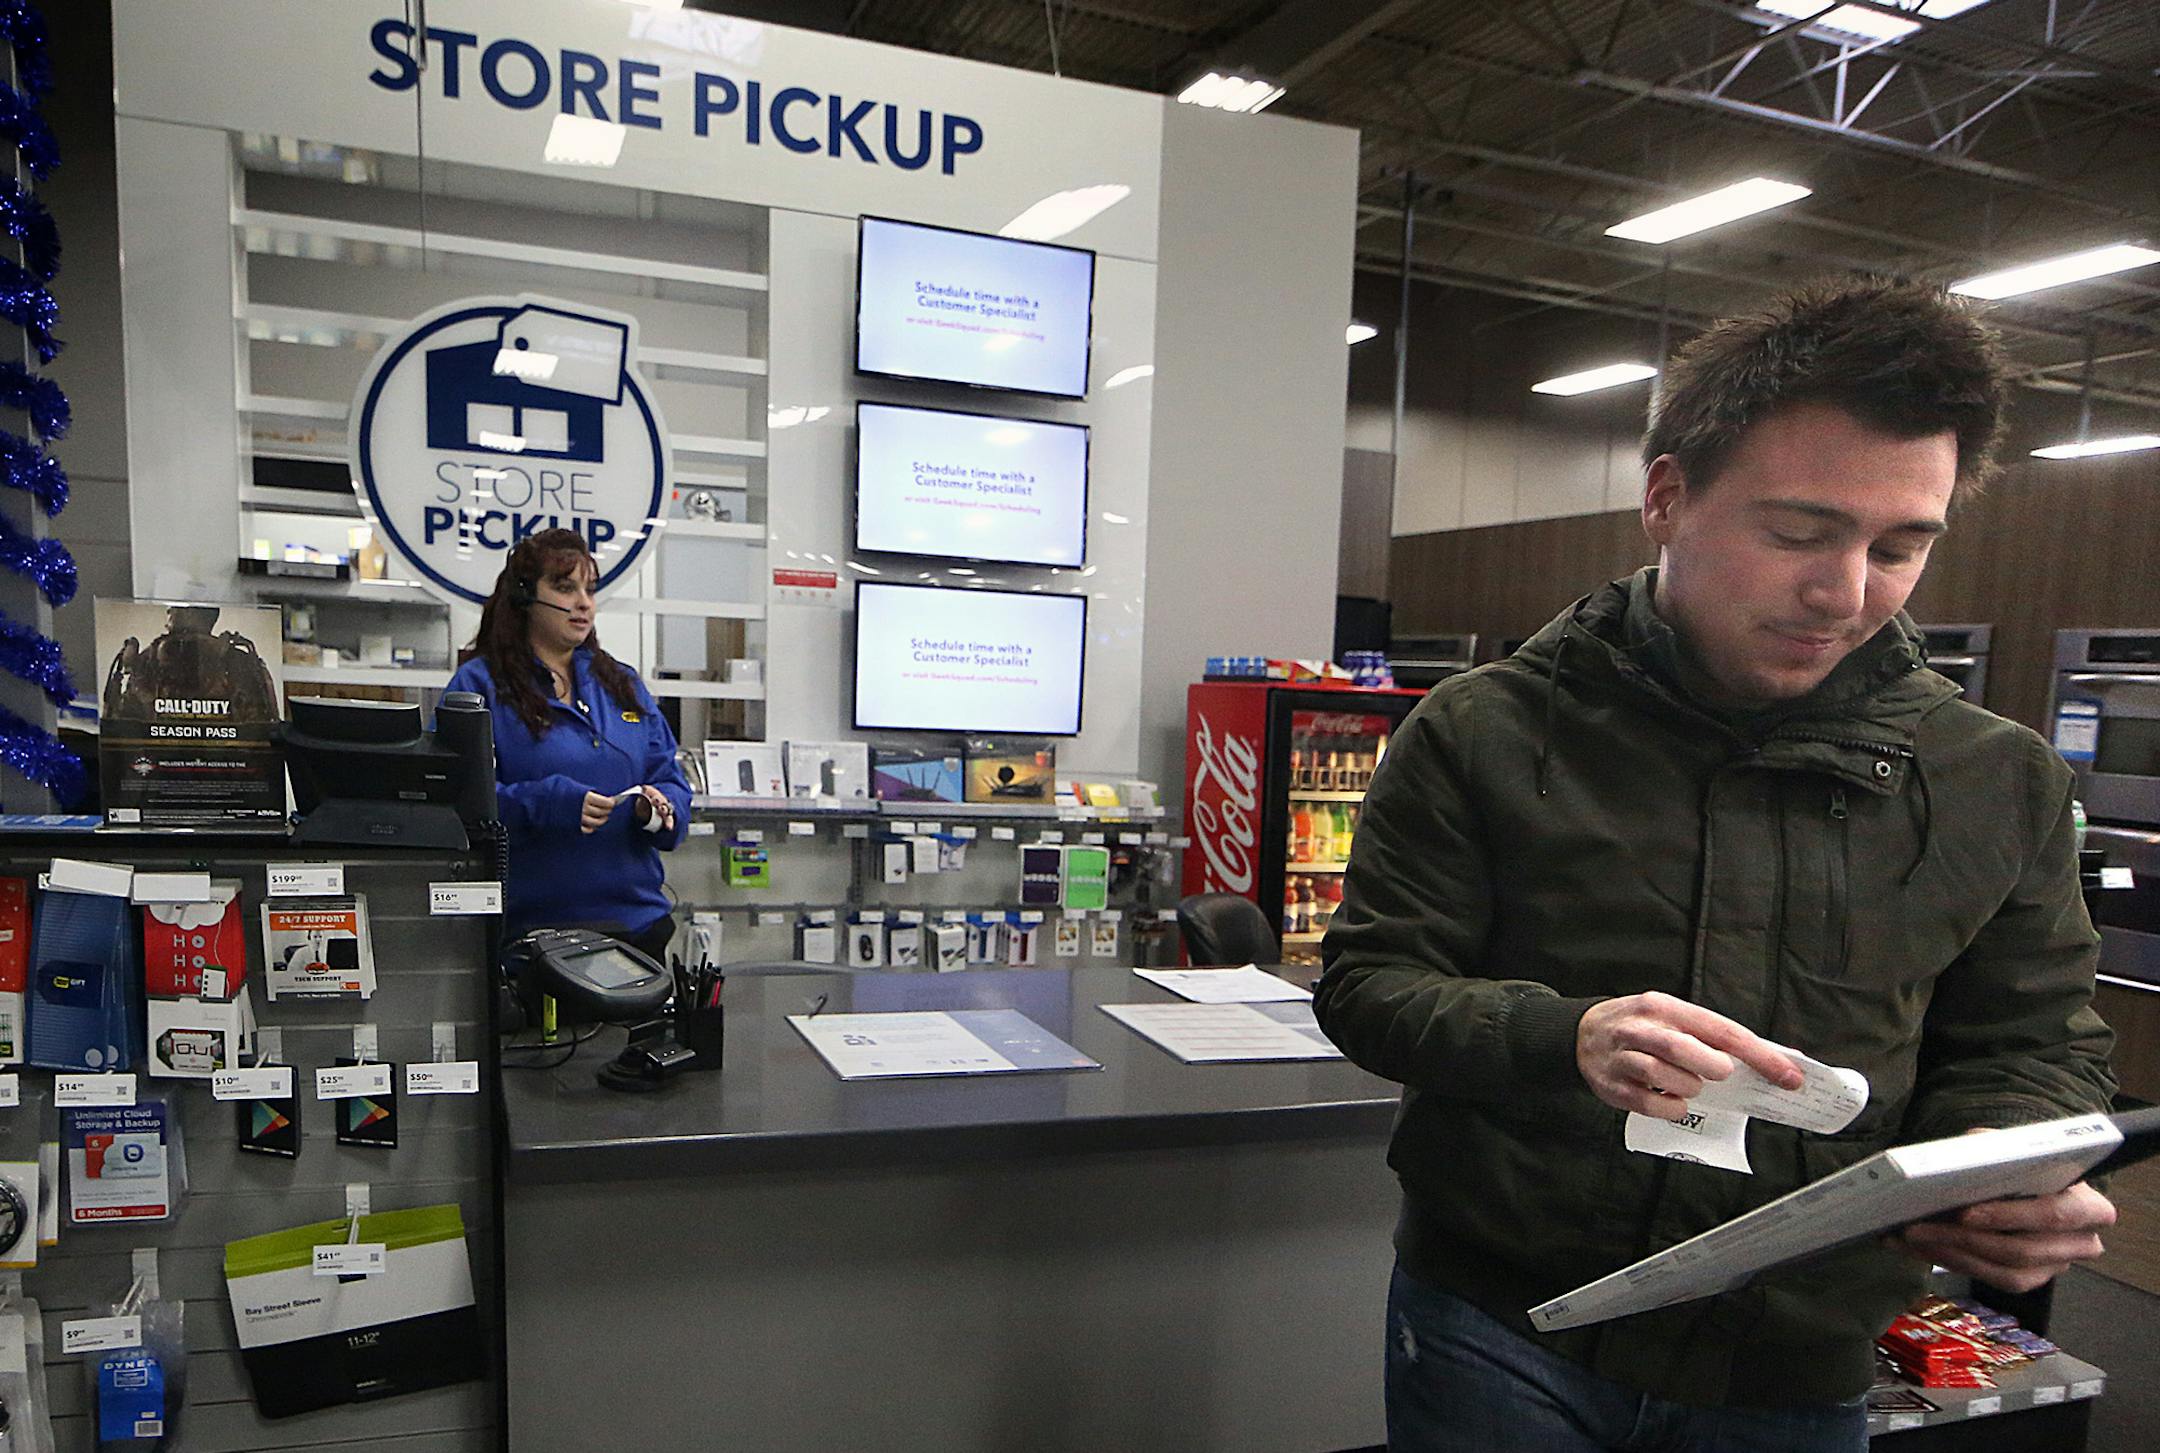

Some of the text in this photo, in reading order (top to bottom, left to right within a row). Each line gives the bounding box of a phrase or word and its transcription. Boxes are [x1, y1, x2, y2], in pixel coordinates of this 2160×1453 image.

[369, 19, 984, 176] STORE PICKUP
[915, 281, 970, 298] Schedule
[974, 290, 1000, 303] time
[1004, 295, 1029, 307] with
[917, 295, 1037, 321] Customer Specialist
[912, 462, 967, 476] Schedule
[971, 468, 996, 480] time
[1000, 472, 1025, 483] with
[436, 461, 595, 513] STORE
[915, 475, 1032, 495] Customer Specialist
[911, 638, 964, 651] Schedule
[969, 642, 994, 652] time
[998, 644, 1022, 654] with
[913, 651, 1029, 668] Customer Specialist
[155, 698, 230, 715] CALL DUTY
[150, 725, 237, 738] SEASON PASS
[303, 915, 346, 923] SUPPORT
[75, 1109, 152, 1119] Unlimited Cloud
[75, 1119, 161, 1130] Storage & Backup
[78, 1208, 123, 1217] 6 Months
[245, 1297, 322, 1315] Bay Street Sleeve
[104, 1359, 156, 1370] DYNEX
